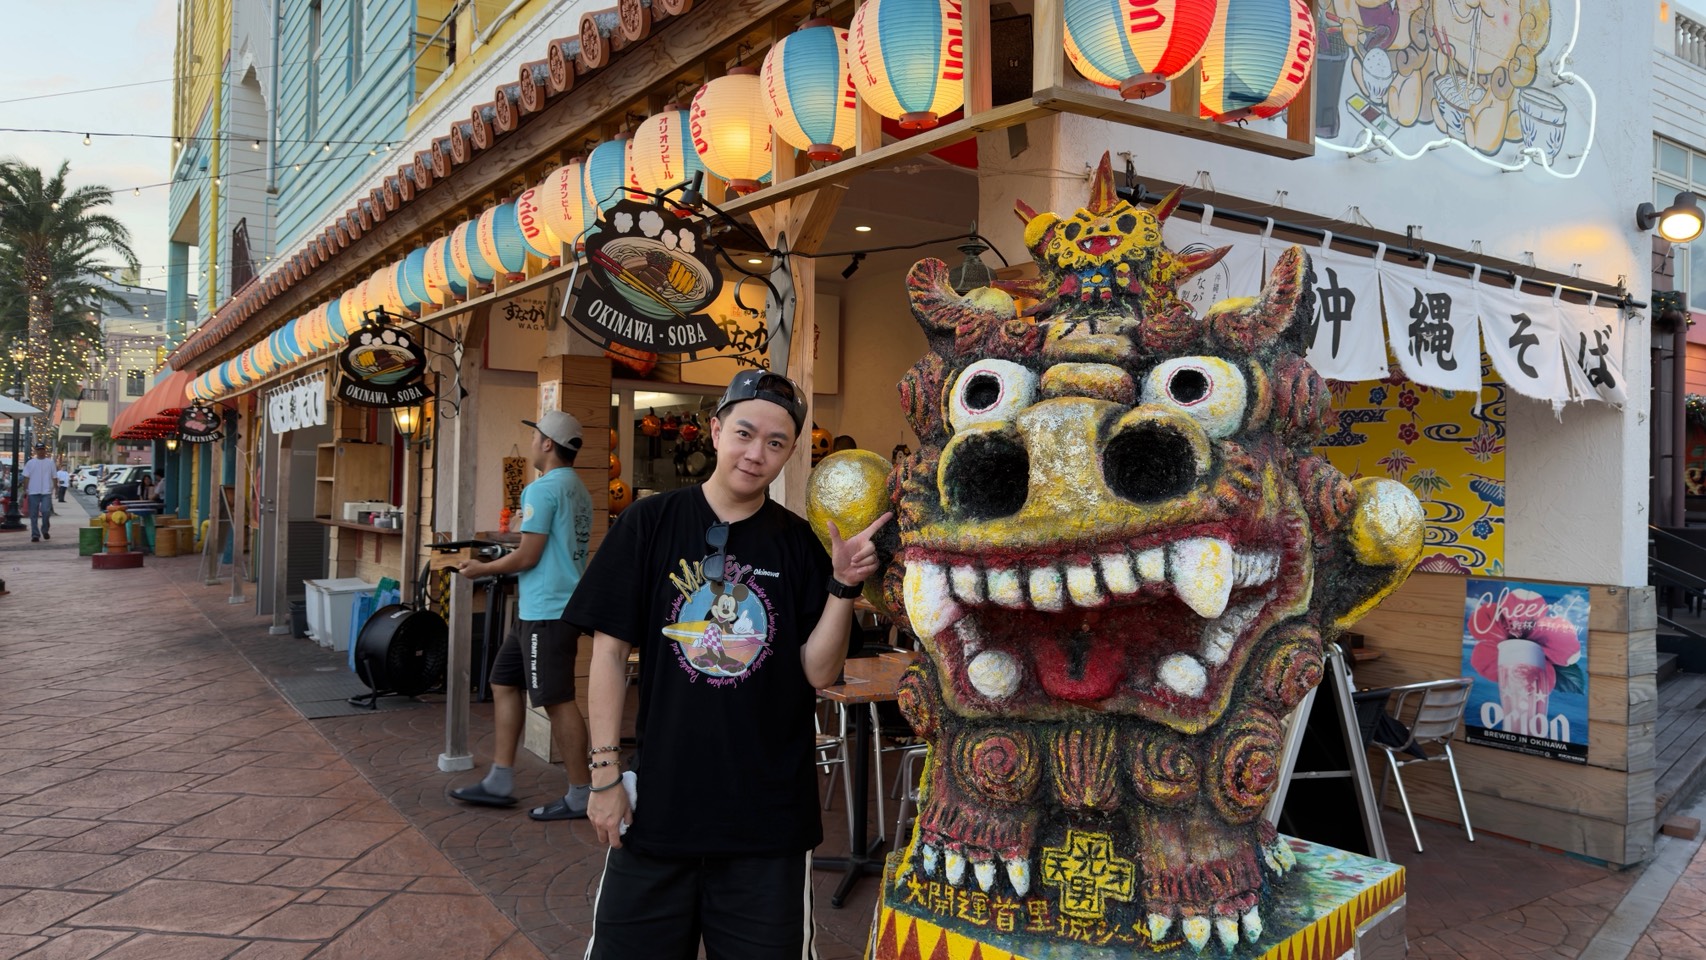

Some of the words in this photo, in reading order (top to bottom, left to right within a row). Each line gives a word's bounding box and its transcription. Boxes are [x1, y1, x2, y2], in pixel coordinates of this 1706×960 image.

[658, 116, 674, 181] オリオンビール
[560, 168, 572, 221] オリオンビール
[517, 189, 540, 239] Orion
[587, 299, 654, 344] OKINAWA
[668, 322, 708, 346] SOBA
[345, 384, 389, 404] OKINAWA
[397, 386, 423, 402] SOBA
[182, 433, 219, 442] YAKINIKU
[753, 568, 780, 578] Okinawa
[1473, 587, 1580, 634] Cheers!
[531, 672, 539, 689] FROG
[1484, 730, 1517, 742] BREWED
[1519, 735, 1527, 744] IN
[1530, 739, 1568, 750] OKINAWA
